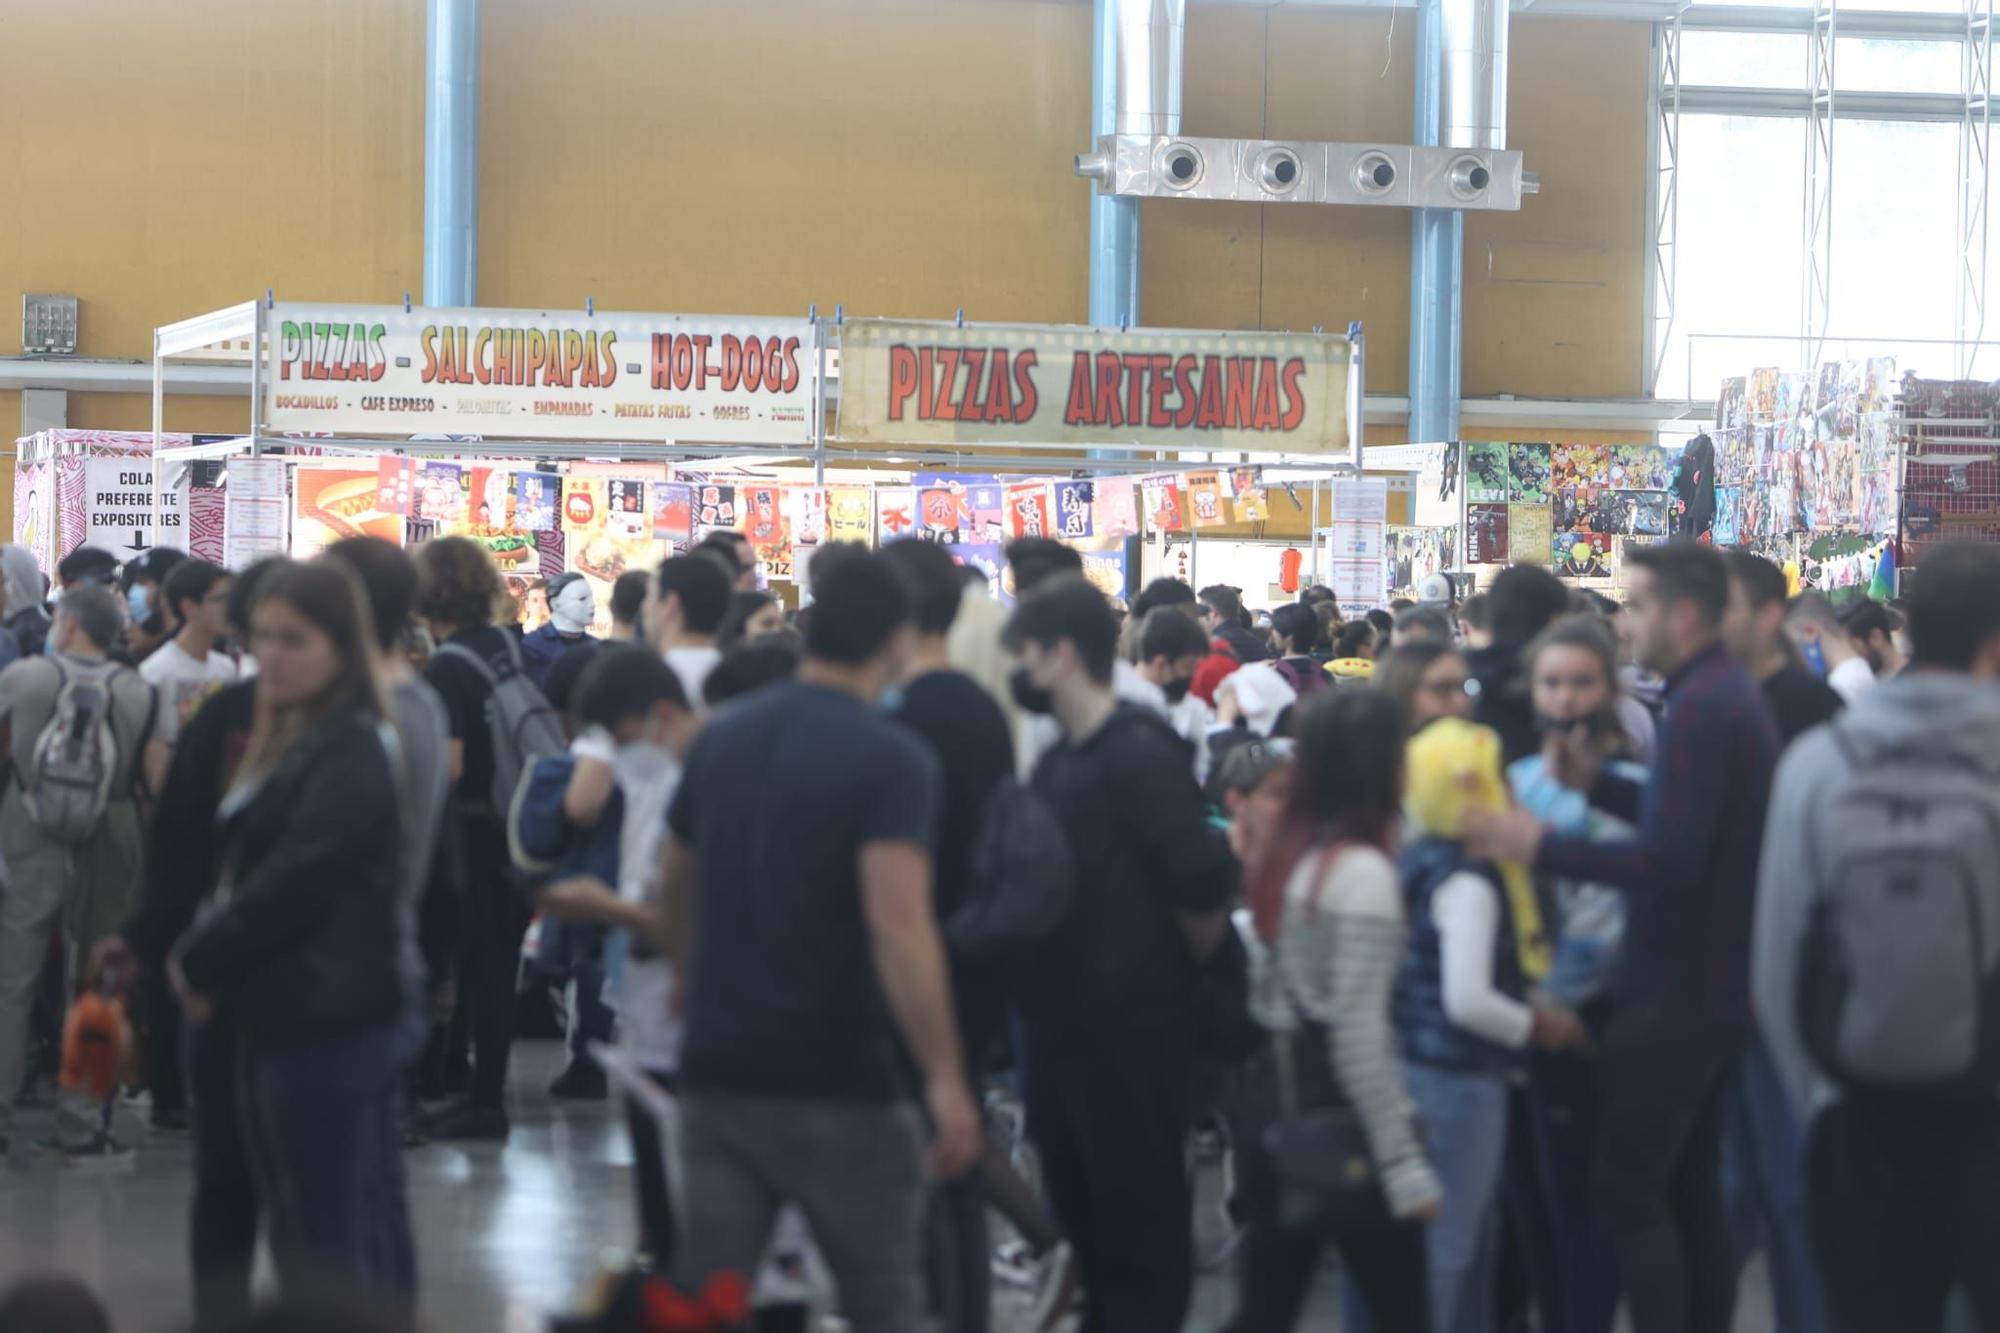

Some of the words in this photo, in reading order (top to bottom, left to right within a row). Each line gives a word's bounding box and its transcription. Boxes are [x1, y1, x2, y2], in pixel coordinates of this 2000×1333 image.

[281, 320, 386, 382] PIZZAS
[420, 325, 617, 388] SALCHIPAPAS
[651, 333, 800, 393] HOT-DOGS
[888, 343, 1039, 424] PIZZAS
[1063, 347, 1306, 432] ARTESANAS
[276, 395, 338, 410] BOCADILLOS
[361, 396, 385, 411] CAFE
[388, 397, 434, 412] EXPRESO
[532, 401, 593, 416] EMPANADAS
[614, 403, 653, 418] PATATAS
[656, 404, 690, 419] FRITAS
[119, 472, 153, 485] COLA
[96, 492, 177, 506] PREFERETE
[1469, 489, 1504, 501] LEVI
